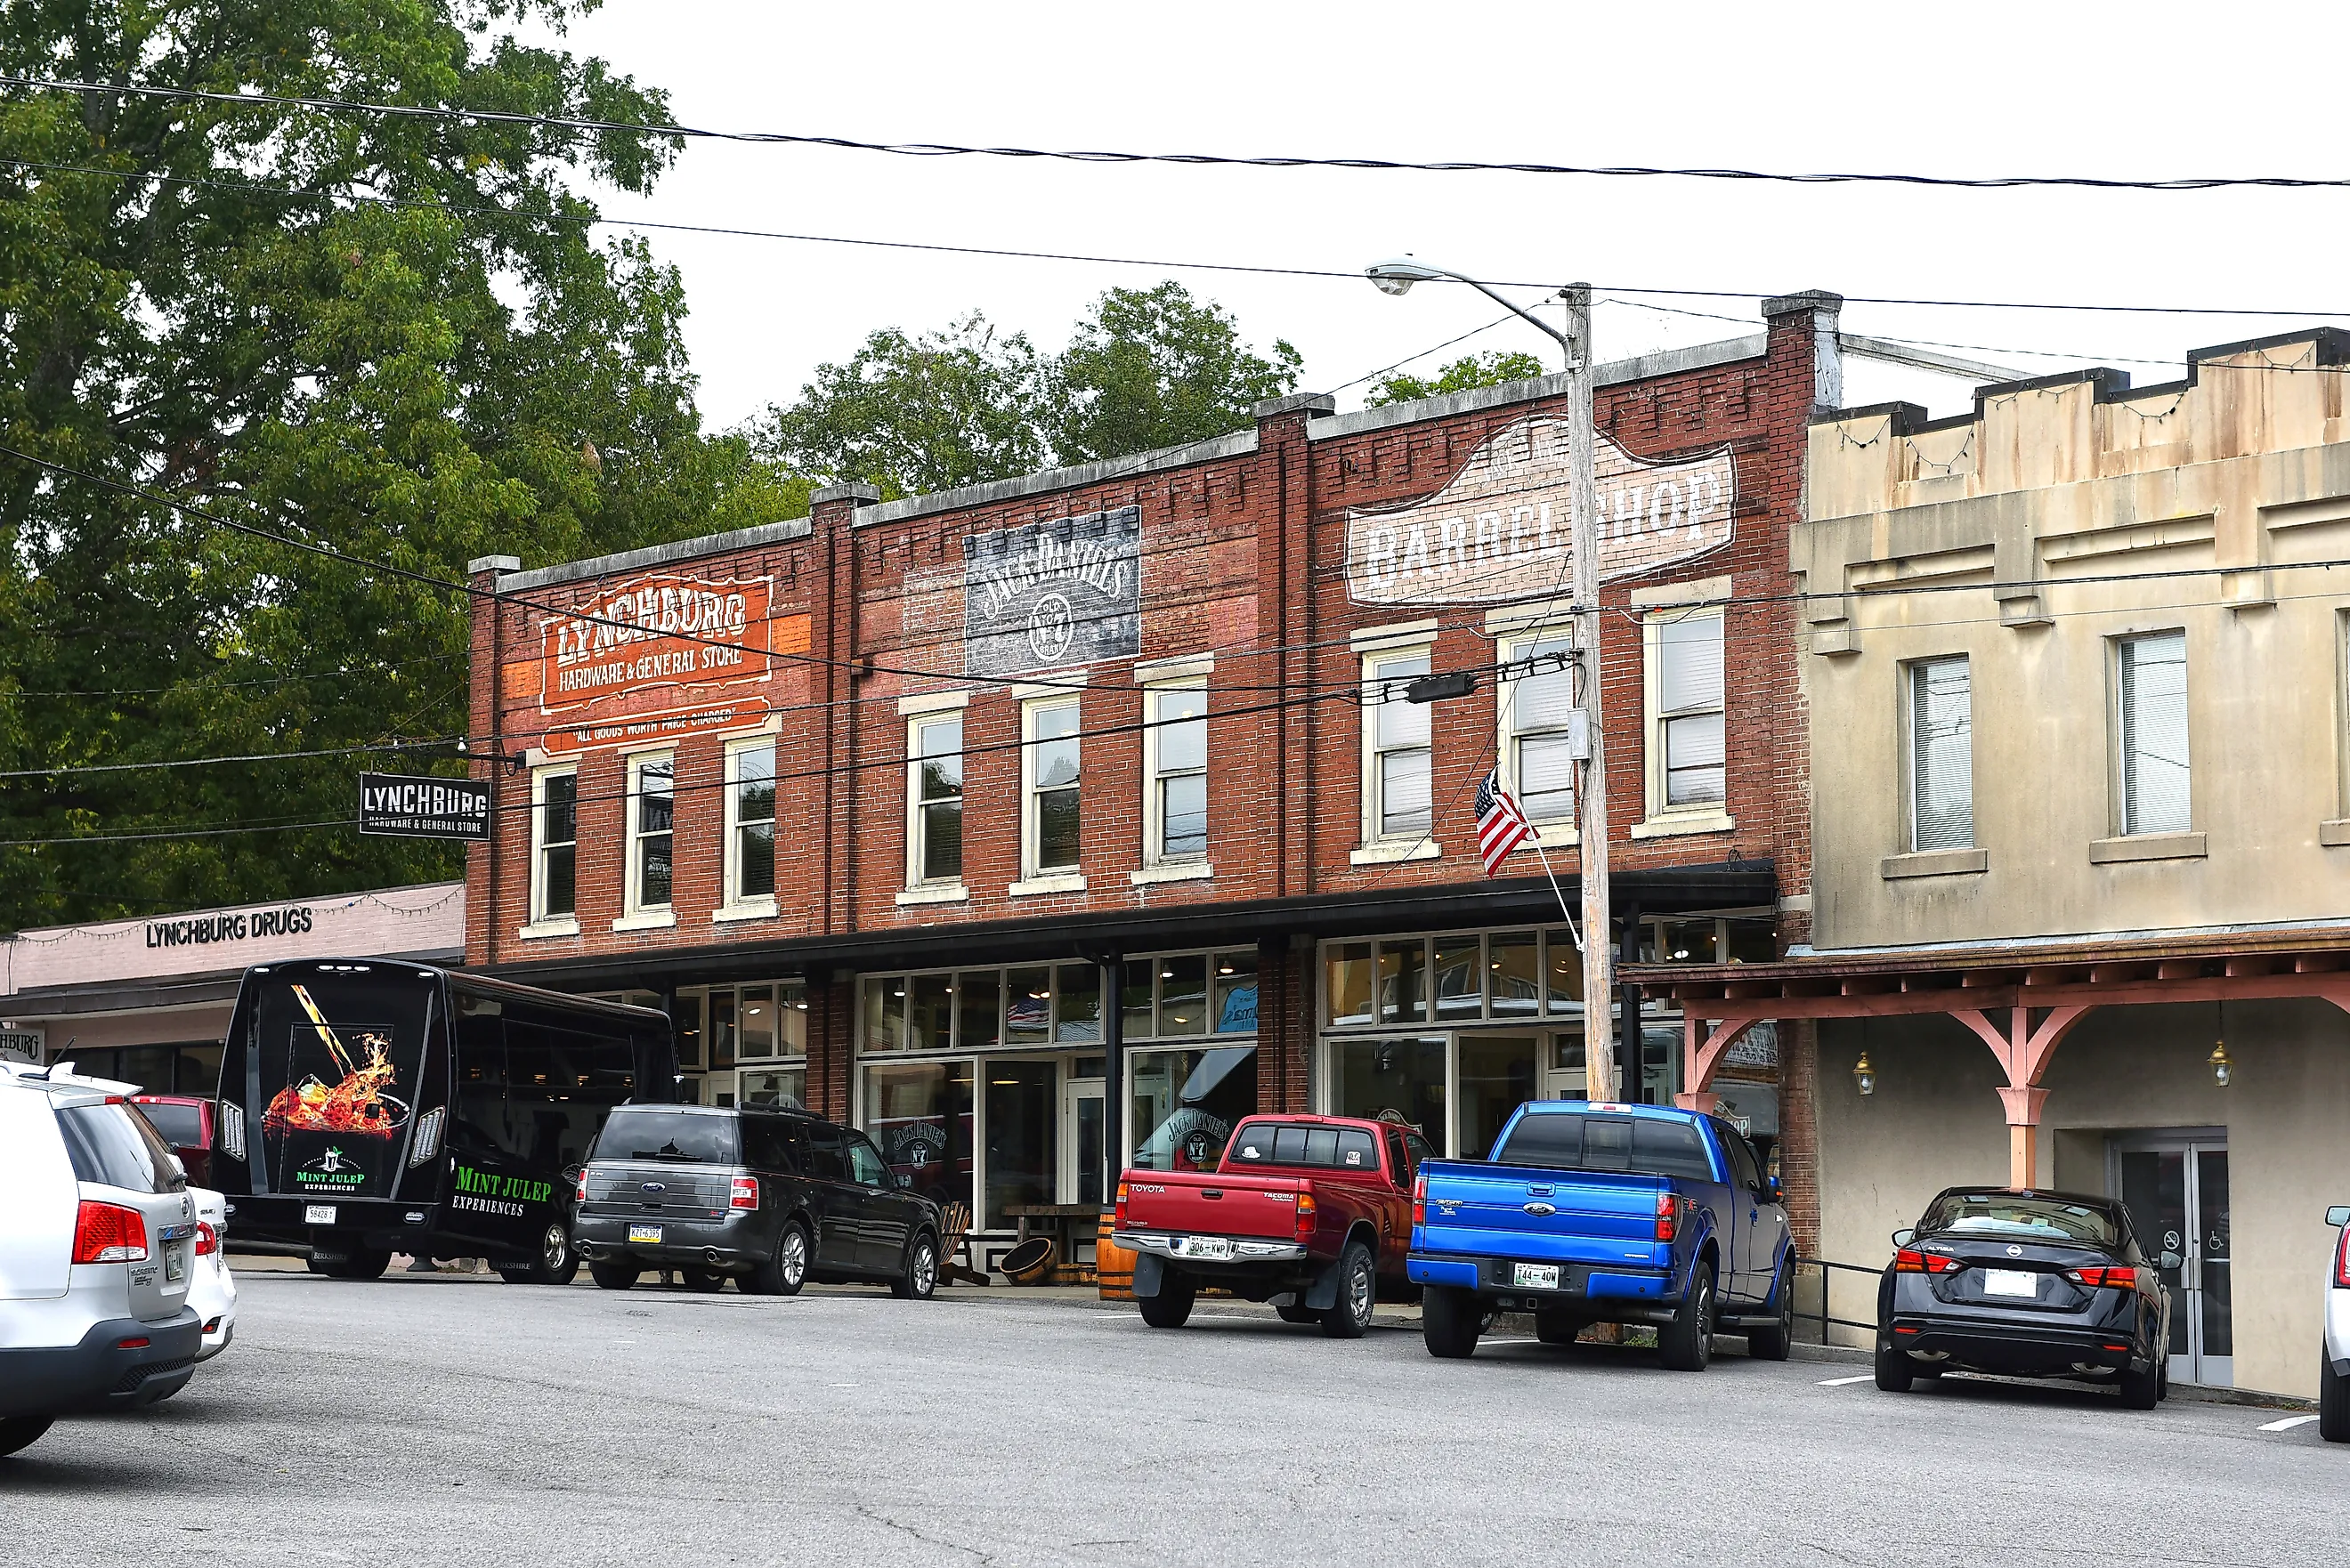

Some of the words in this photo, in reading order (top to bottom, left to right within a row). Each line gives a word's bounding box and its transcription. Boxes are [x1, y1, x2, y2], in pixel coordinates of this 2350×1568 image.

[1365, 501, 1563, 590] BARREL
[557, 587, 747, 667] LYNCHBURG
[559, 662, 624, 691] HARDWARE
[626, 664, 635, 681] &
[636, 649, 696, 680] GENERAL
[701, 641, 743, 669] STORE
[595, 724, 624, 740] GOODS
[628, 718, 658, 735] WORTH
[661, 715, 687, 731] PRICE
[364, 784, 487, 818] LYNCHBURG
[369, 815, 412, 828] HARDWARE
[413, 820, 420, 829] &
[422, 819, 456, 831] GENERAL
[457, 820, 482, 833] STORE
[146, 914, 247, 949] LYNCHBURG
[251, 908, 312, 938] DRUGS
[893, 1124, 914, 1151] JACK
[1167, 1115, 1191, 1143] JACK
[296, 1171, 328, 1183] MINT
[328, 1174, 366, 1184] JULEP
[304, 1184, 355, 1192] EXPERIENCES
[455, 1166, 501, 1195] MINT
[502, 1177, 552, 1202] JULEP
[1130, 1184, 1165, 1194] TOYOTA
[451, 1195, 524, 1217] EXPERIENCES
